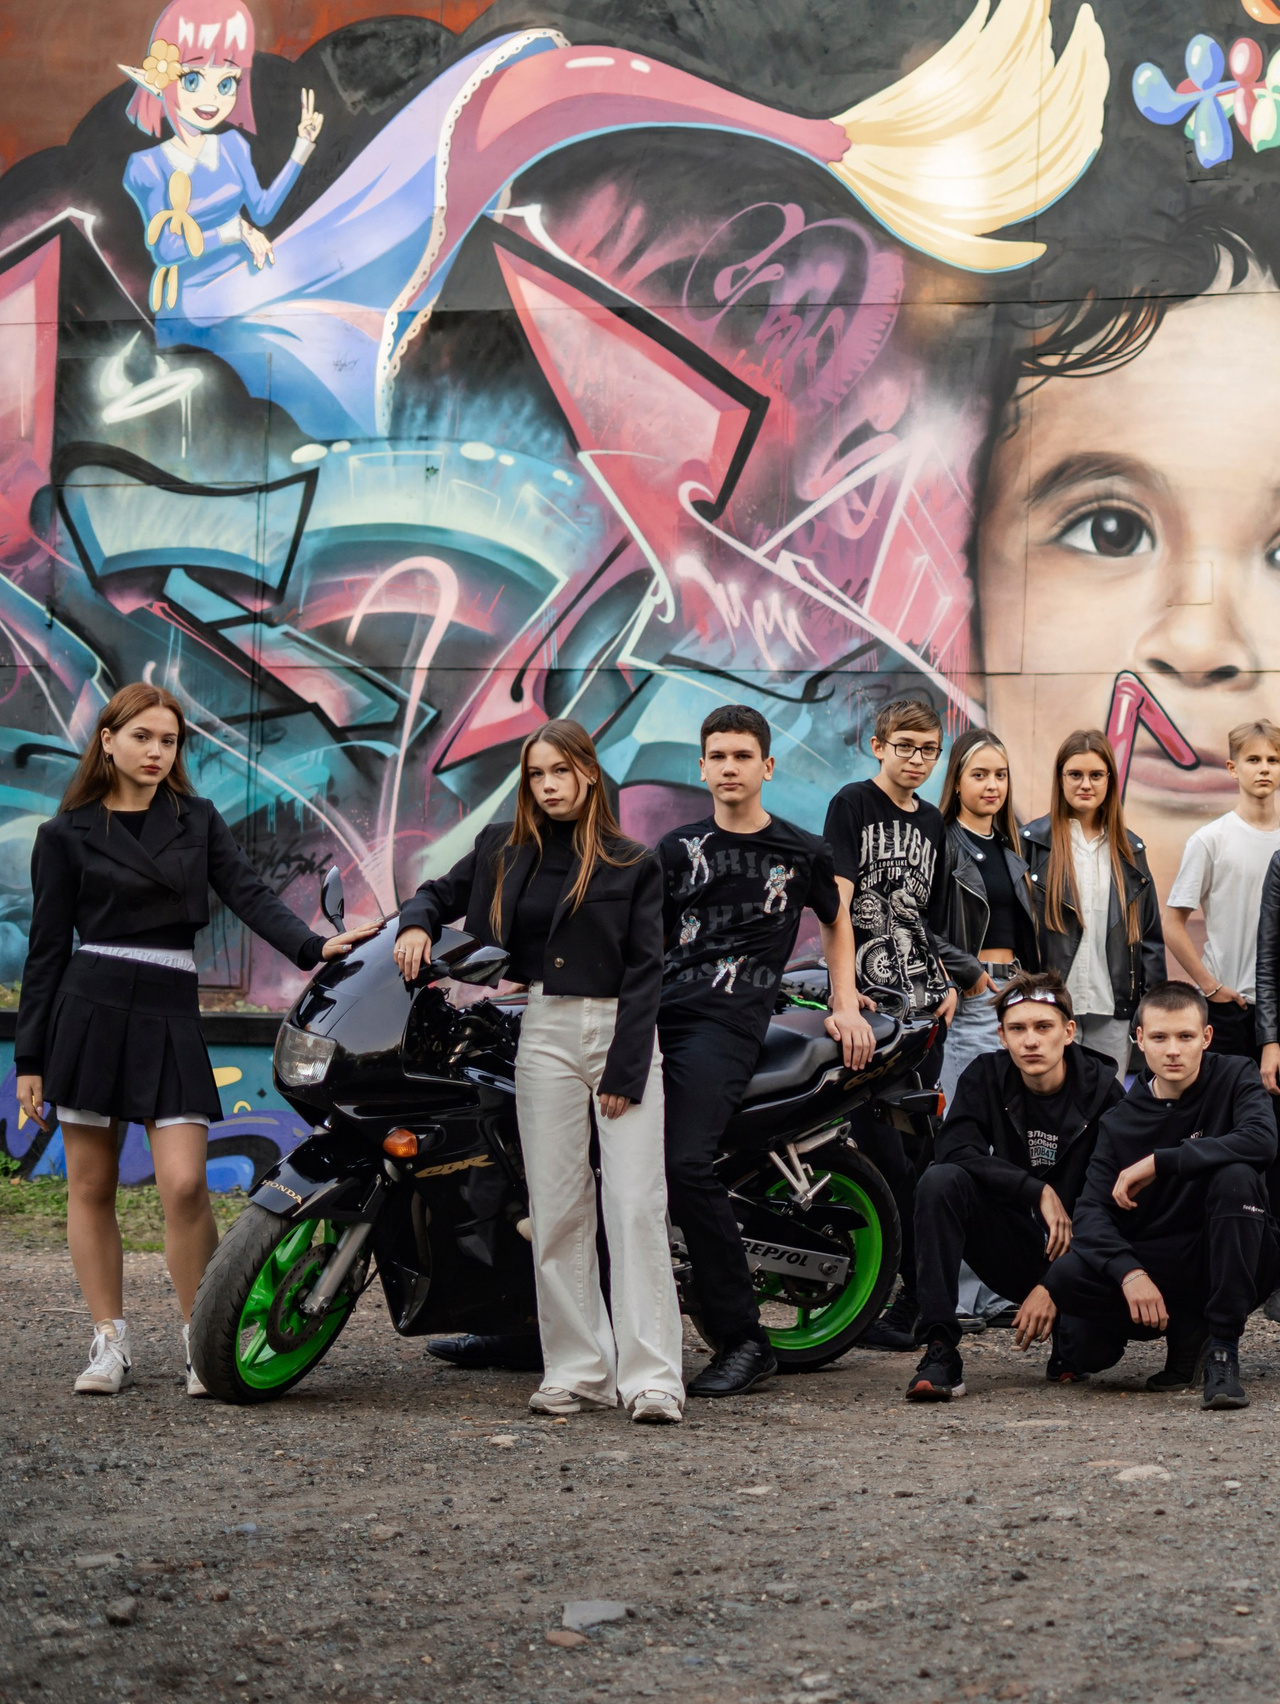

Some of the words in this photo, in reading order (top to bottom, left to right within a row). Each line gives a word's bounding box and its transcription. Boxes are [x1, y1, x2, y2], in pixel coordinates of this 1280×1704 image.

[878, 859, 895, 868] LOOK
[895, 859, 908, 867] LIKE
[860, 868, 885, 891] SHUT
[887, 866, 902, 880] UP
[414, 1154, 496, 1179] CBR
[260, 1178, 303, 1205] HONDA
[741, 1240, 809, 1267] REPSOL
